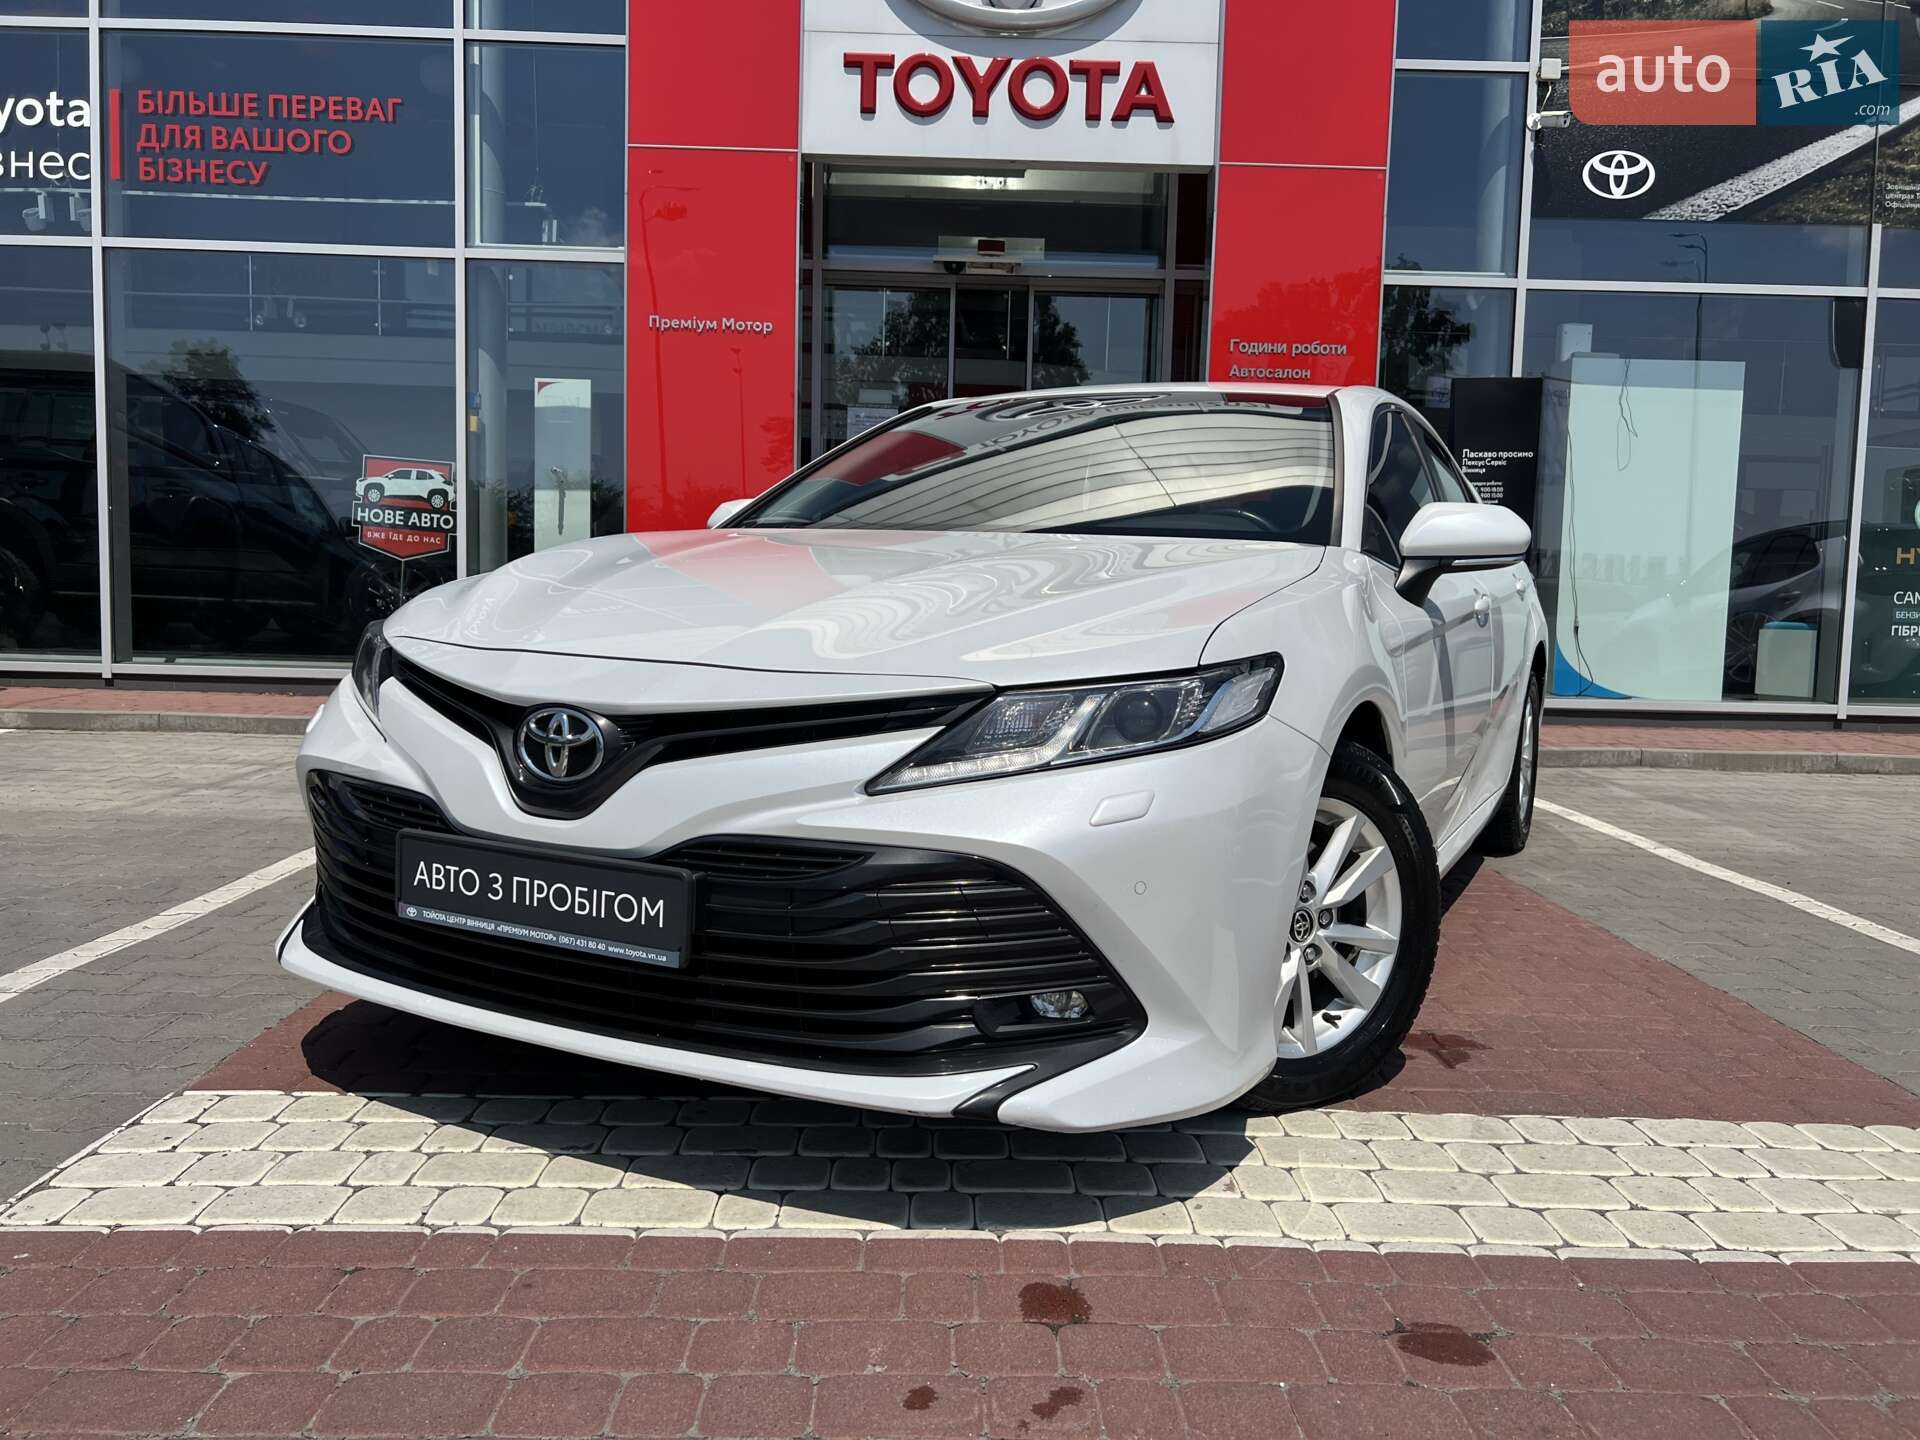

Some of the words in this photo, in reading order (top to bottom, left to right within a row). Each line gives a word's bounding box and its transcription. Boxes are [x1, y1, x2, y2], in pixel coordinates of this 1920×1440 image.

[843, 52, 1175, 123] TOYOTA
[137, 89, 259, 118] БІЛЬШЕ
[267, 93, 402, 122] ПЕРЕВАГ
[136, 123, 201, 153] ДЛЯ
[210, 126, 353, 155] ВАШОГО
[138, 157, 268, 185] БІЗНЕСУ
[649, 314, 717, 332] Преміум
[722, 317, 773, 335] Мотор
[1230, 338, 1287, 355] Години
[1292, 341, 1347, 357] роботи
[1229, 364, 1311, 379] Автосалон
[1462, 448, 1497, 458] Ласкаво
[1498, 451, 1533, 459] просимо
[357, 507, 404, 525] НОВЕ
[408, 511, 454, 530] АВТО
[367, 531, 386, 539] ВЖЕ
[423, 536, 441, 544] НАС
[413, 860, 480, 896] АВТО
[487, 873, 503, 901] З
[512, 876, 665, 928] ПРОБІГОМ
[422, 910, 446, 921] ТОЙОТА
[446, 915, 466, 925] ЦЕНТР
[558, 934, 576, 947] (067)
[576, 938, 587, 948] 431
[587, 940, 596, 949] 80
[597, 942, 606, 951] 40
[607, 944, 667, 962] www.toyota.vn.ua
